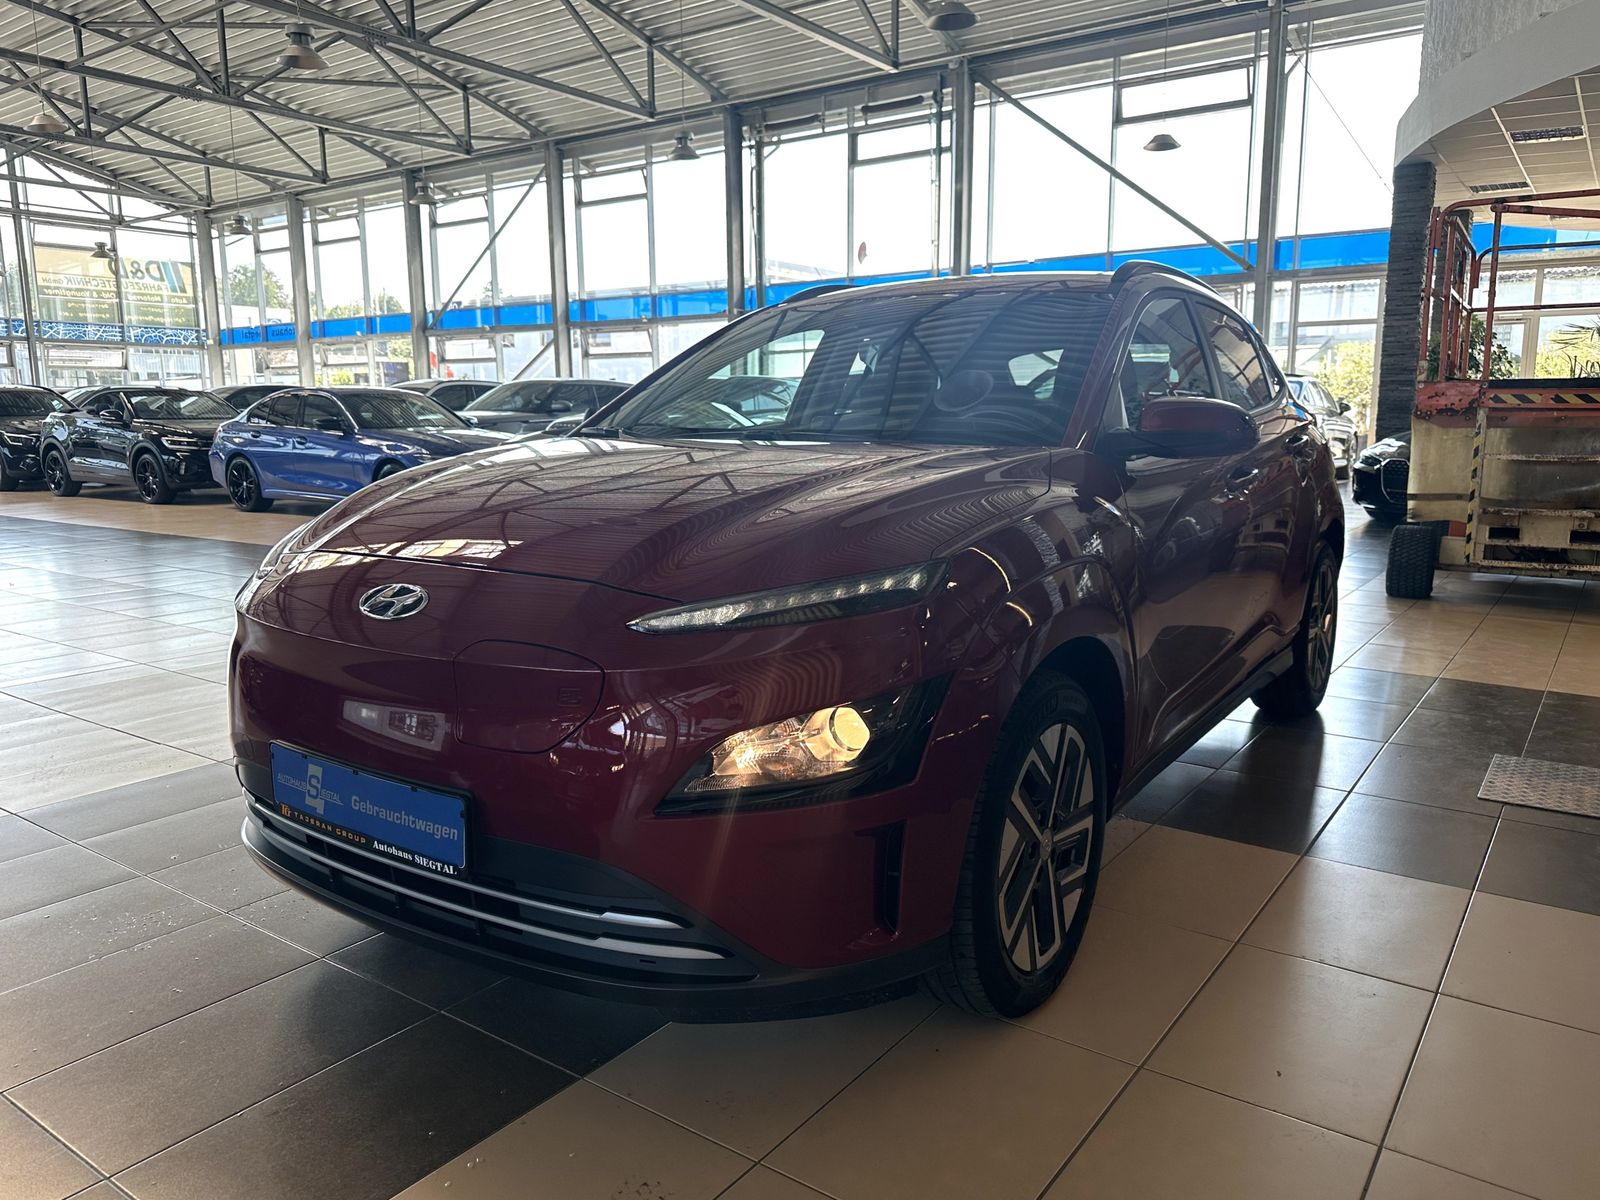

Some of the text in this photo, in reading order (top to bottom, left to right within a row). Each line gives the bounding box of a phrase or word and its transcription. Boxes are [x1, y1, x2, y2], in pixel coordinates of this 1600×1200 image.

[277, 772, 307, 790] AUTOHAUS
[351, 795, 458, 840] Gebrauchtwagen
[335, 828, 366, 844] GROUP
[372, 840, 458, 876] Autohaus SIEGTAL
